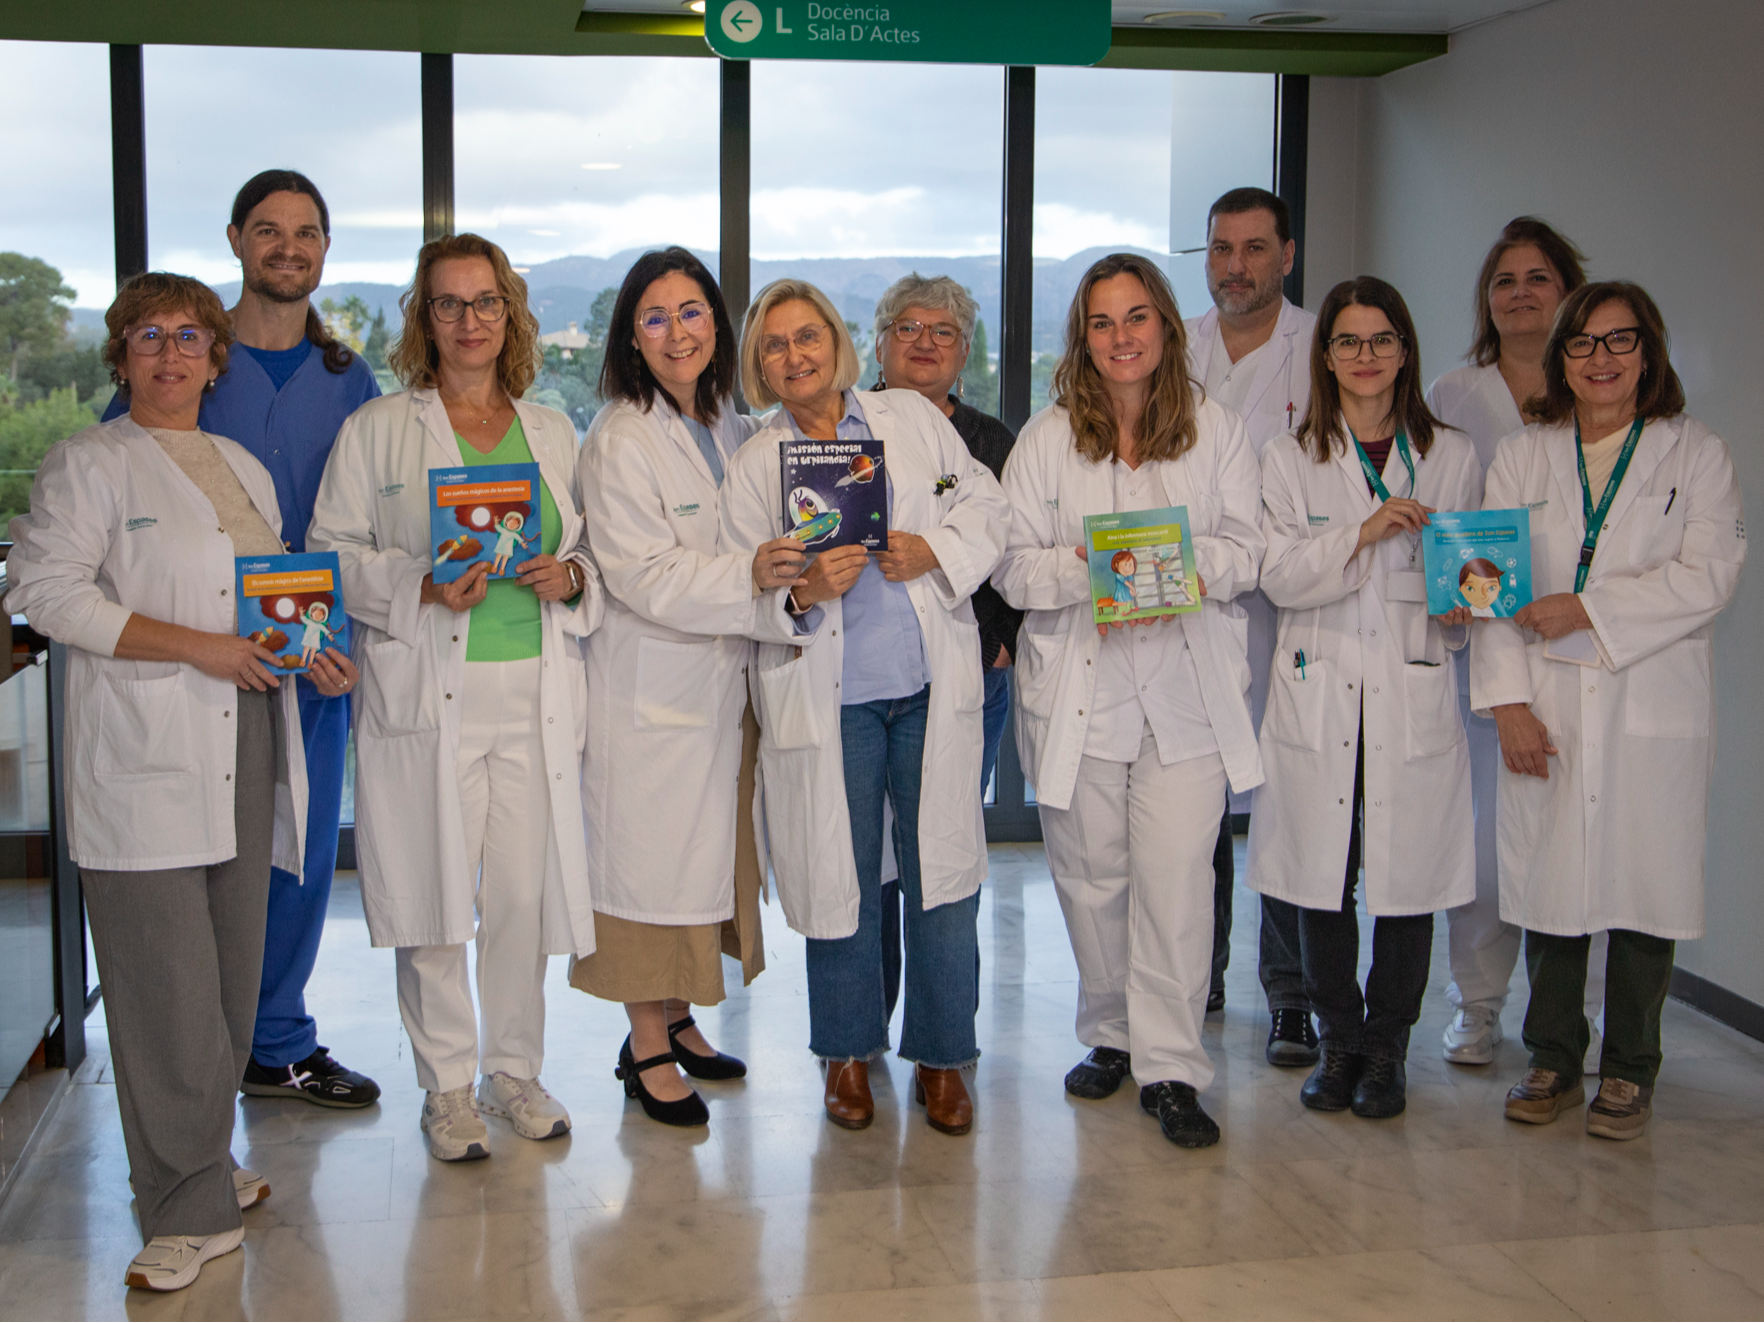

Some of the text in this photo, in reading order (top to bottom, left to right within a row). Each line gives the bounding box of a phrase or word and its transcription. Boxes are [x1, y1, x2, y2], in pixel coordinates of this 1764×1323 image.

[776, 2, 890, 34] L Docència
[807, 23, 846, 41] Sala
[787, 456, 799, 466] en
[452, 488, 469, 496] sueños
[469, 487, 490, 497] mágicos
[502, 485, 525, 493] anestesia
[1124, 531, 1147, 540] infermera
[1495, 529, 1516, 537] Espases
[259, 578, 275, 586] somnis
